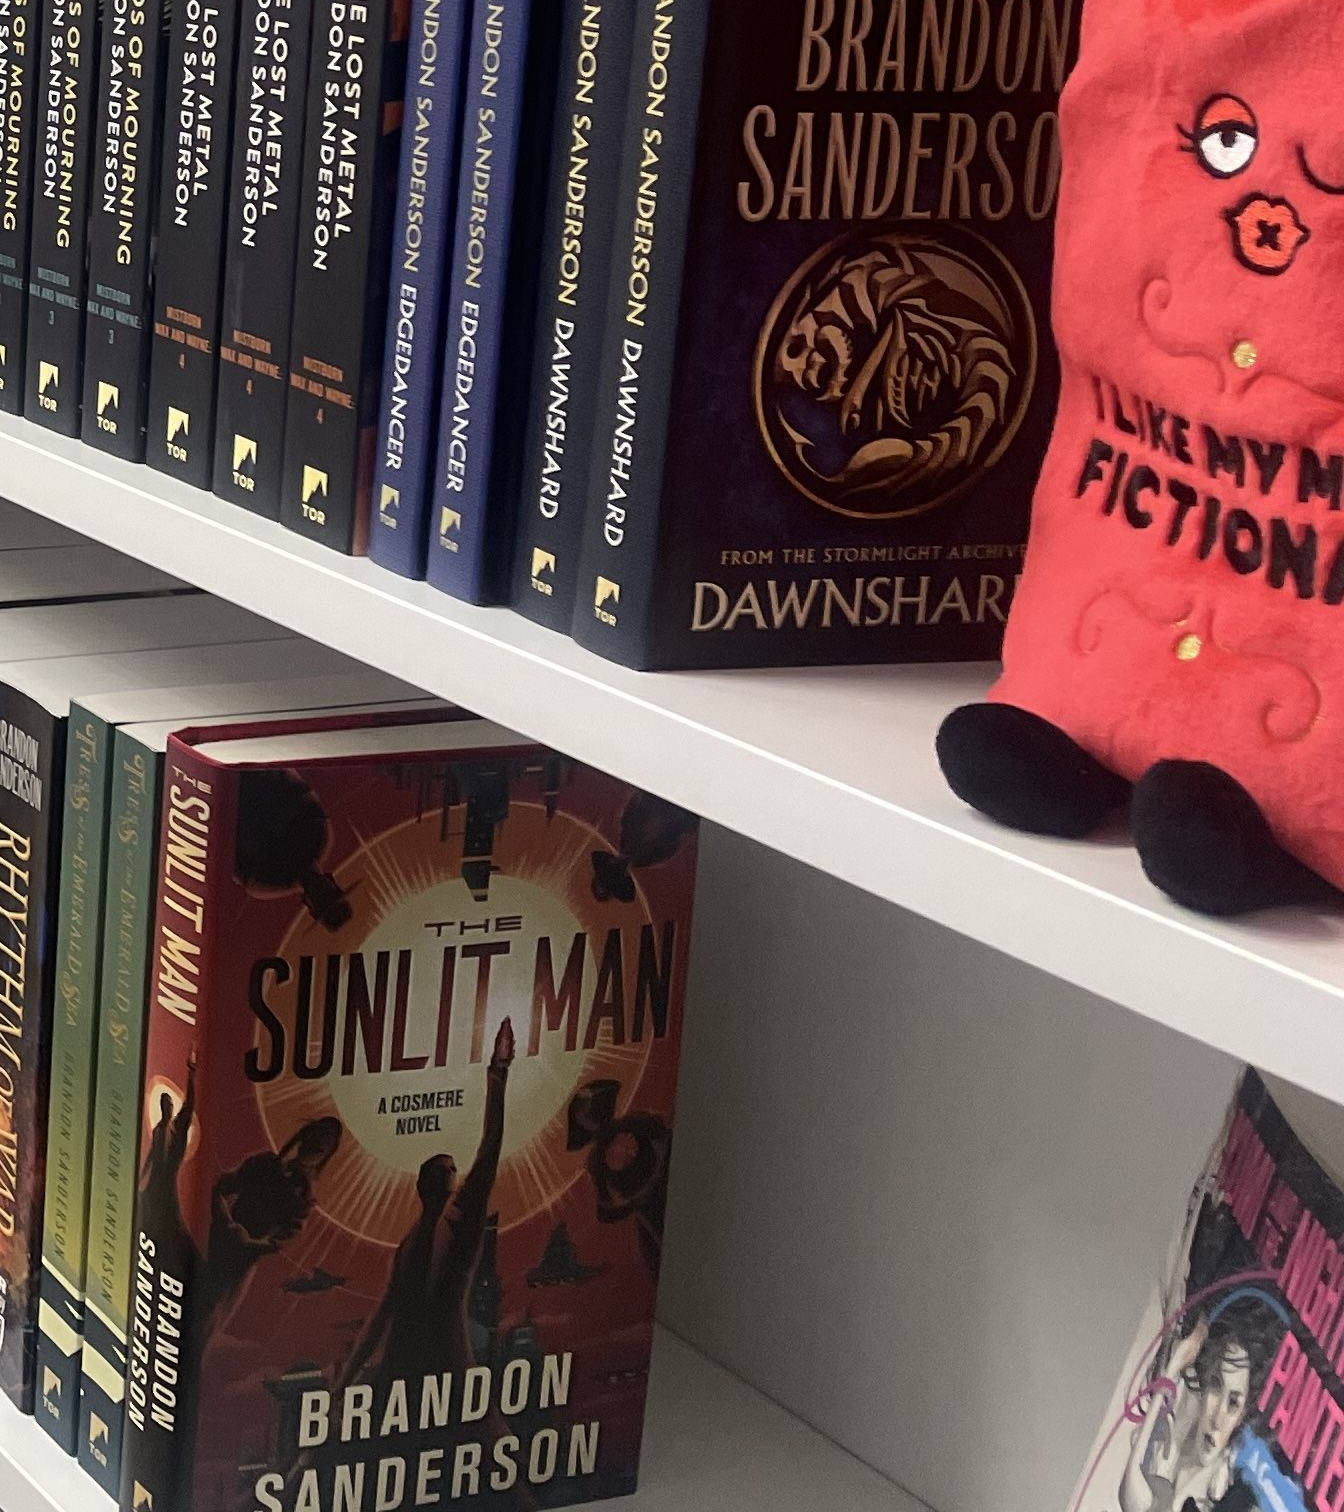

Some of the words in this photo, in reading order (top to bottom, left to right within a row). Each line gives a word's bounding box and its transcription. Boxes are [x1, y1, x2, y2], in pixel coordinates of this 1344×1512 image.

[65, 26, 81, 69] OF
[343, 35, 366, 120] LOST
[55, 76, 78, 249] MOURNING
[312, 81, 341, 271] SANDERSON
[333, 129, 359, 239] METAL
[737, 104, 1063, 222] SANDERSO
[625, 127, 663, 328] SANDERSON
[385, 282, 417, 472] EDGEDANCER
[602, 338, 643, 548] DAWNSHARD
[1109, 385, 1192, 464] LIKE
[1206, 422, 1287, 495] MY
[302, 502, 326, 526] TOR
[720, 548, 773, 567] FROM
[782, 547, 816, 565] THE
[822, 544, 943, 564] STORMLIGHT
[691, 573, 1018, 633] DAWNSHAR
[164, 781, 211, 936] SUNLIT
[156, 925, 203, 1026] MAN
[423, 915, 524, 937] THE
[243, 940, 512, 1084] SUNLIT
[526, 919, 676, 1057] MAN
[377, 1096, 387, 1115] A
[391, 1089, 465, 1114] COSMERE
[395, 1114, 442, 1136] NOVEL
[127, 1230, 157, 1432] SANDERSON
[150, 1270, 184, 1432] BRANDON
[298, 1351, 574, 1449] BRANDON
[253, 1421, 601, 1512] SANDERSON
